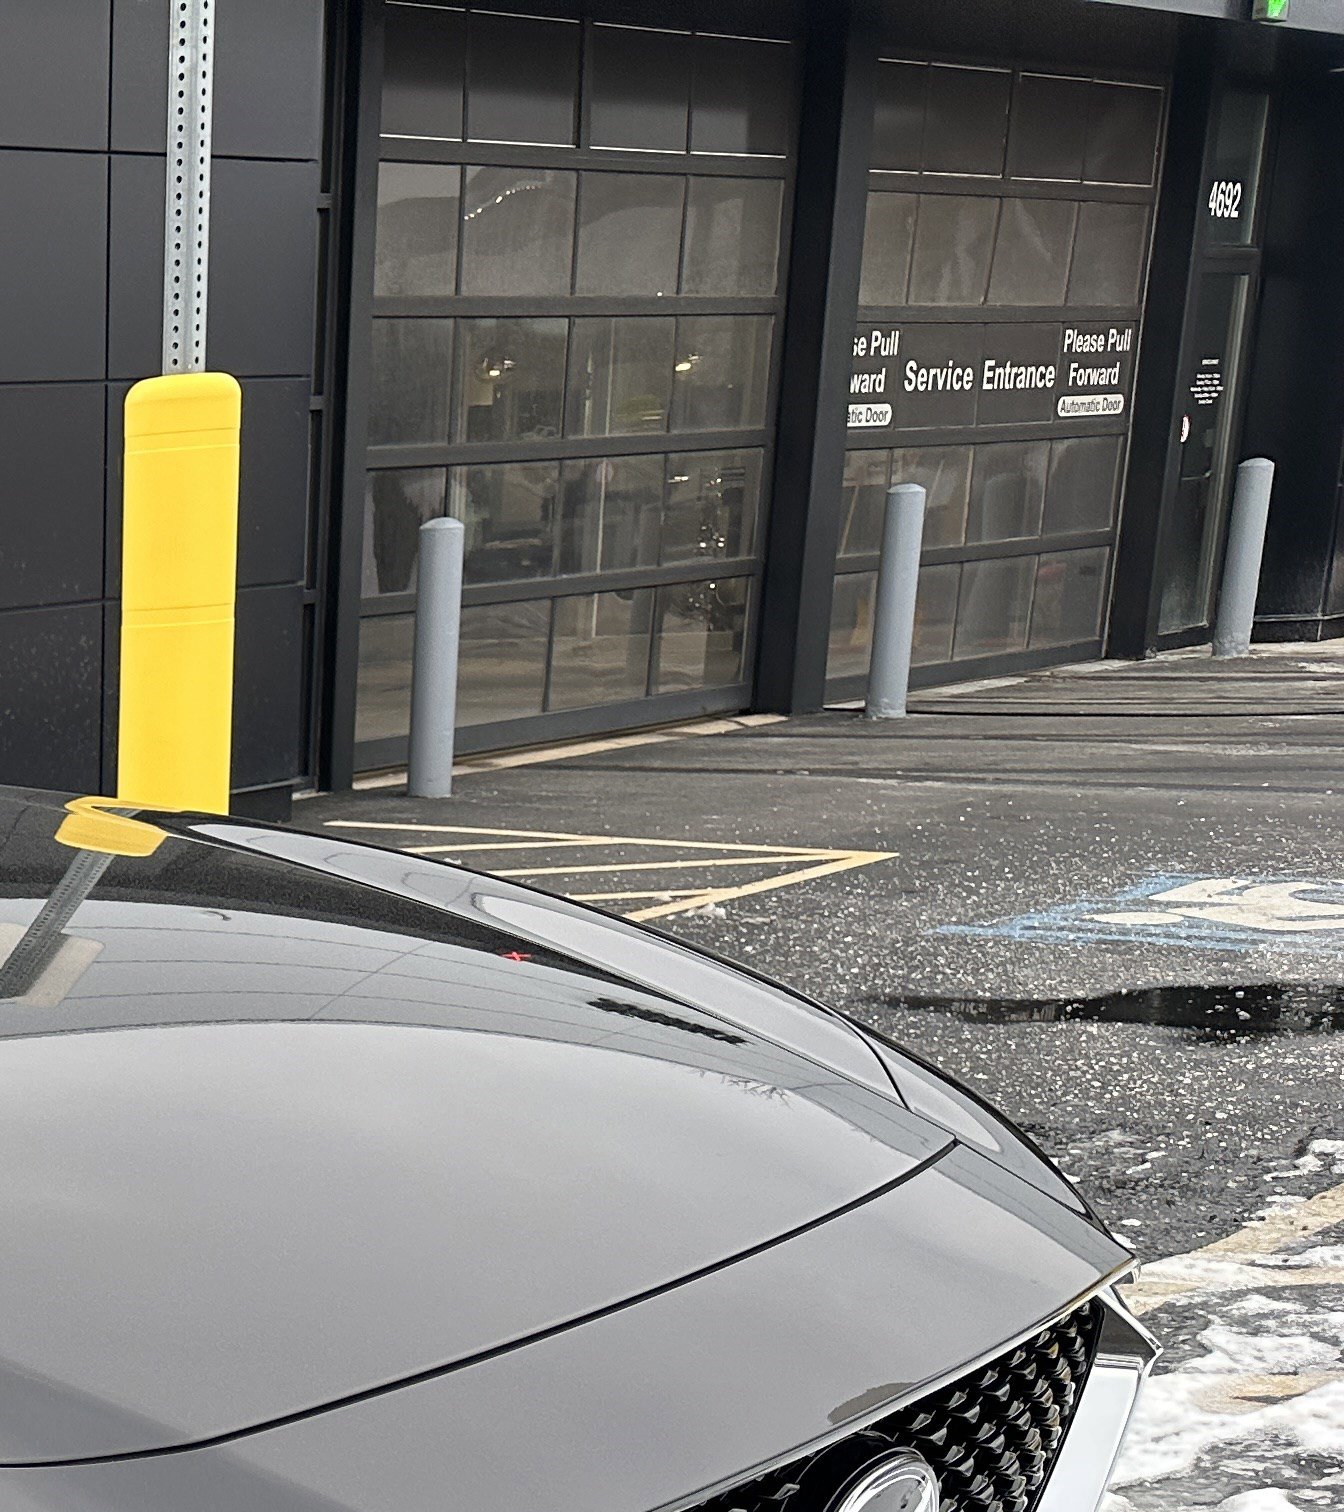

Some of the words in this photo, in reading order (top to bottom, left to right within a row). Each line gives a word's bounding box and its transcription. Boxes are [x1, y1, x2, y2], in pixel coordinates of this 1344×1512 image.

[1209, 181, 1242, 218] 4692
[870, 330, 900, 356] Pull
[1063, 329, 1105, 353] Please
[1107, 328, 1132, 352] Pull
[904, 360, 974, 392] Service
[982, 359, 1055, 390] Entrance
[1068, 361, 1120, 386] Forward
[865, 406, 889, 423] Door
[1060, 398, 1101, 414] Automatic
[1102, 396, 1122, 412] Door
